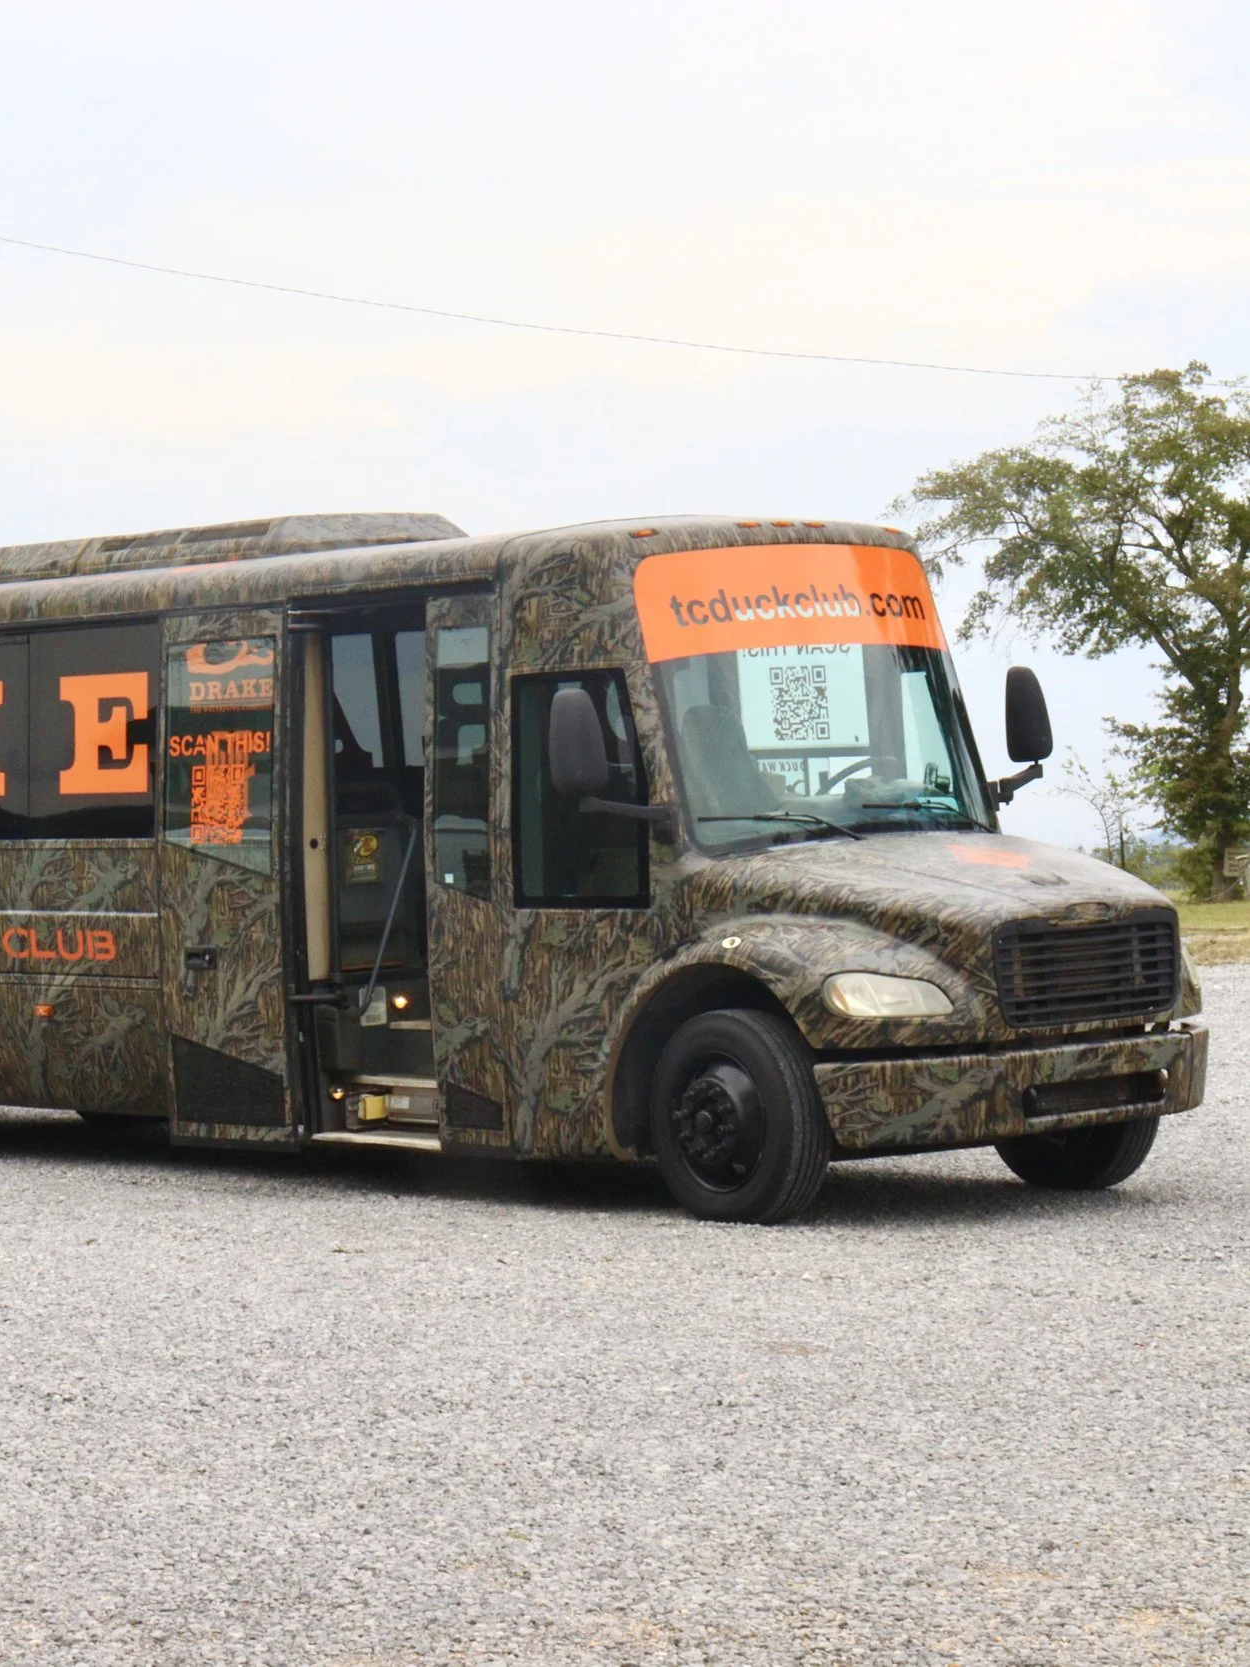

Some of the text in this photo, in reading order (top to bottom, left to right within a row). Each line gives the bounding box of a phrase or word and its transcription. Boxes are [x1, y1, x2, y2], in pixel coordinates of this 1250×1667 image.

[670, 584, 926, 627] tcduckclub.com
[189, 678, 273, 700] DRAKE
[169, 730, 270, 757] SCAN THIS!
[3, 926, 117, 961] CLUB
